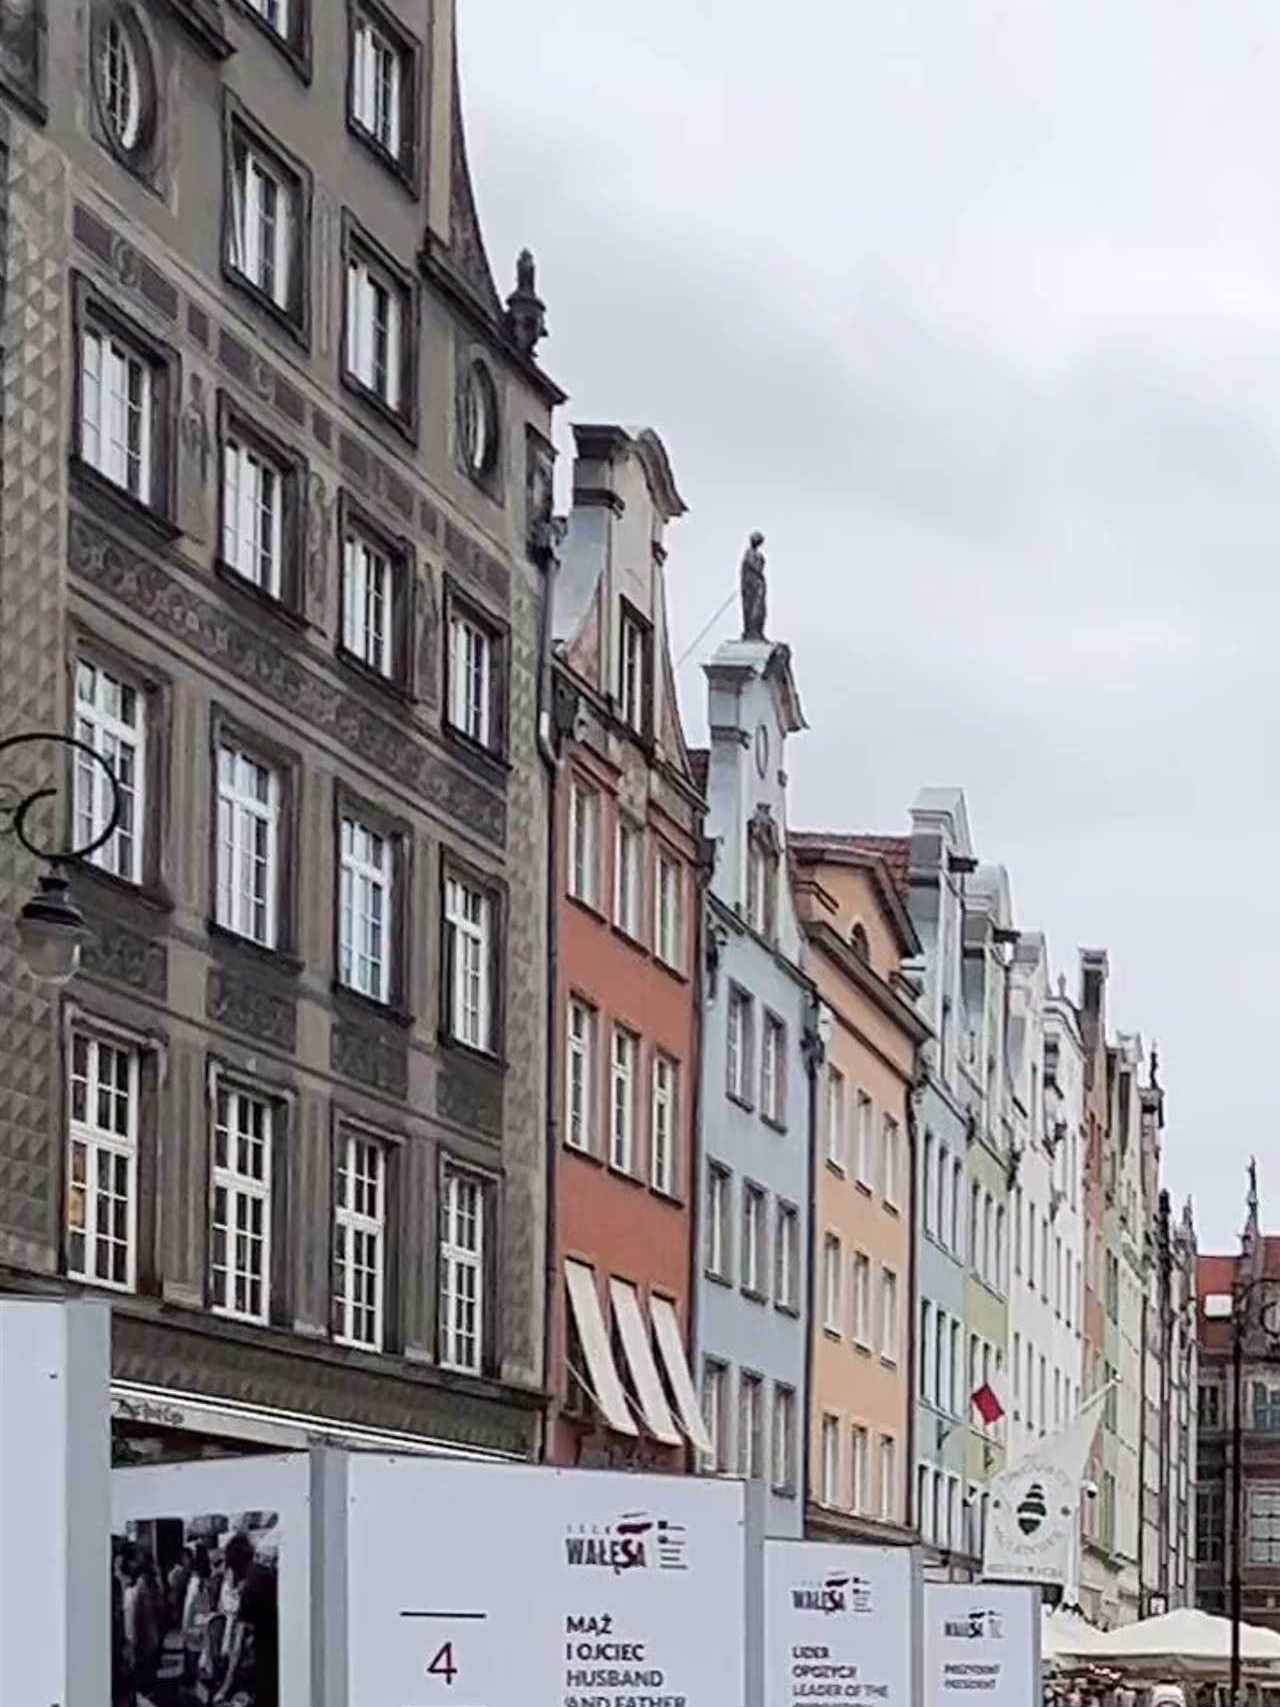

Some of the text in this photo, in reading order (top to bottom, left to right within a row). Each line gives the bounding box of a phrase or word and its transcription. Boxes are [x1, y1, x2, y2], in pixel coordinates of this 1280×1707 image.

[566, 1538, 647, 1575] WAŁĘSA
[566, 1613, 613, 1637] MĄŻ
[427, 1641, 458, 1685] 4
[566, 1643, 645, 1662] I OJCIEC
[566, 1669, 664, 1688] HUSBAND
[793, 1684, 842, 1696] LEADER
[845, 1684, 862, 1696] OF
